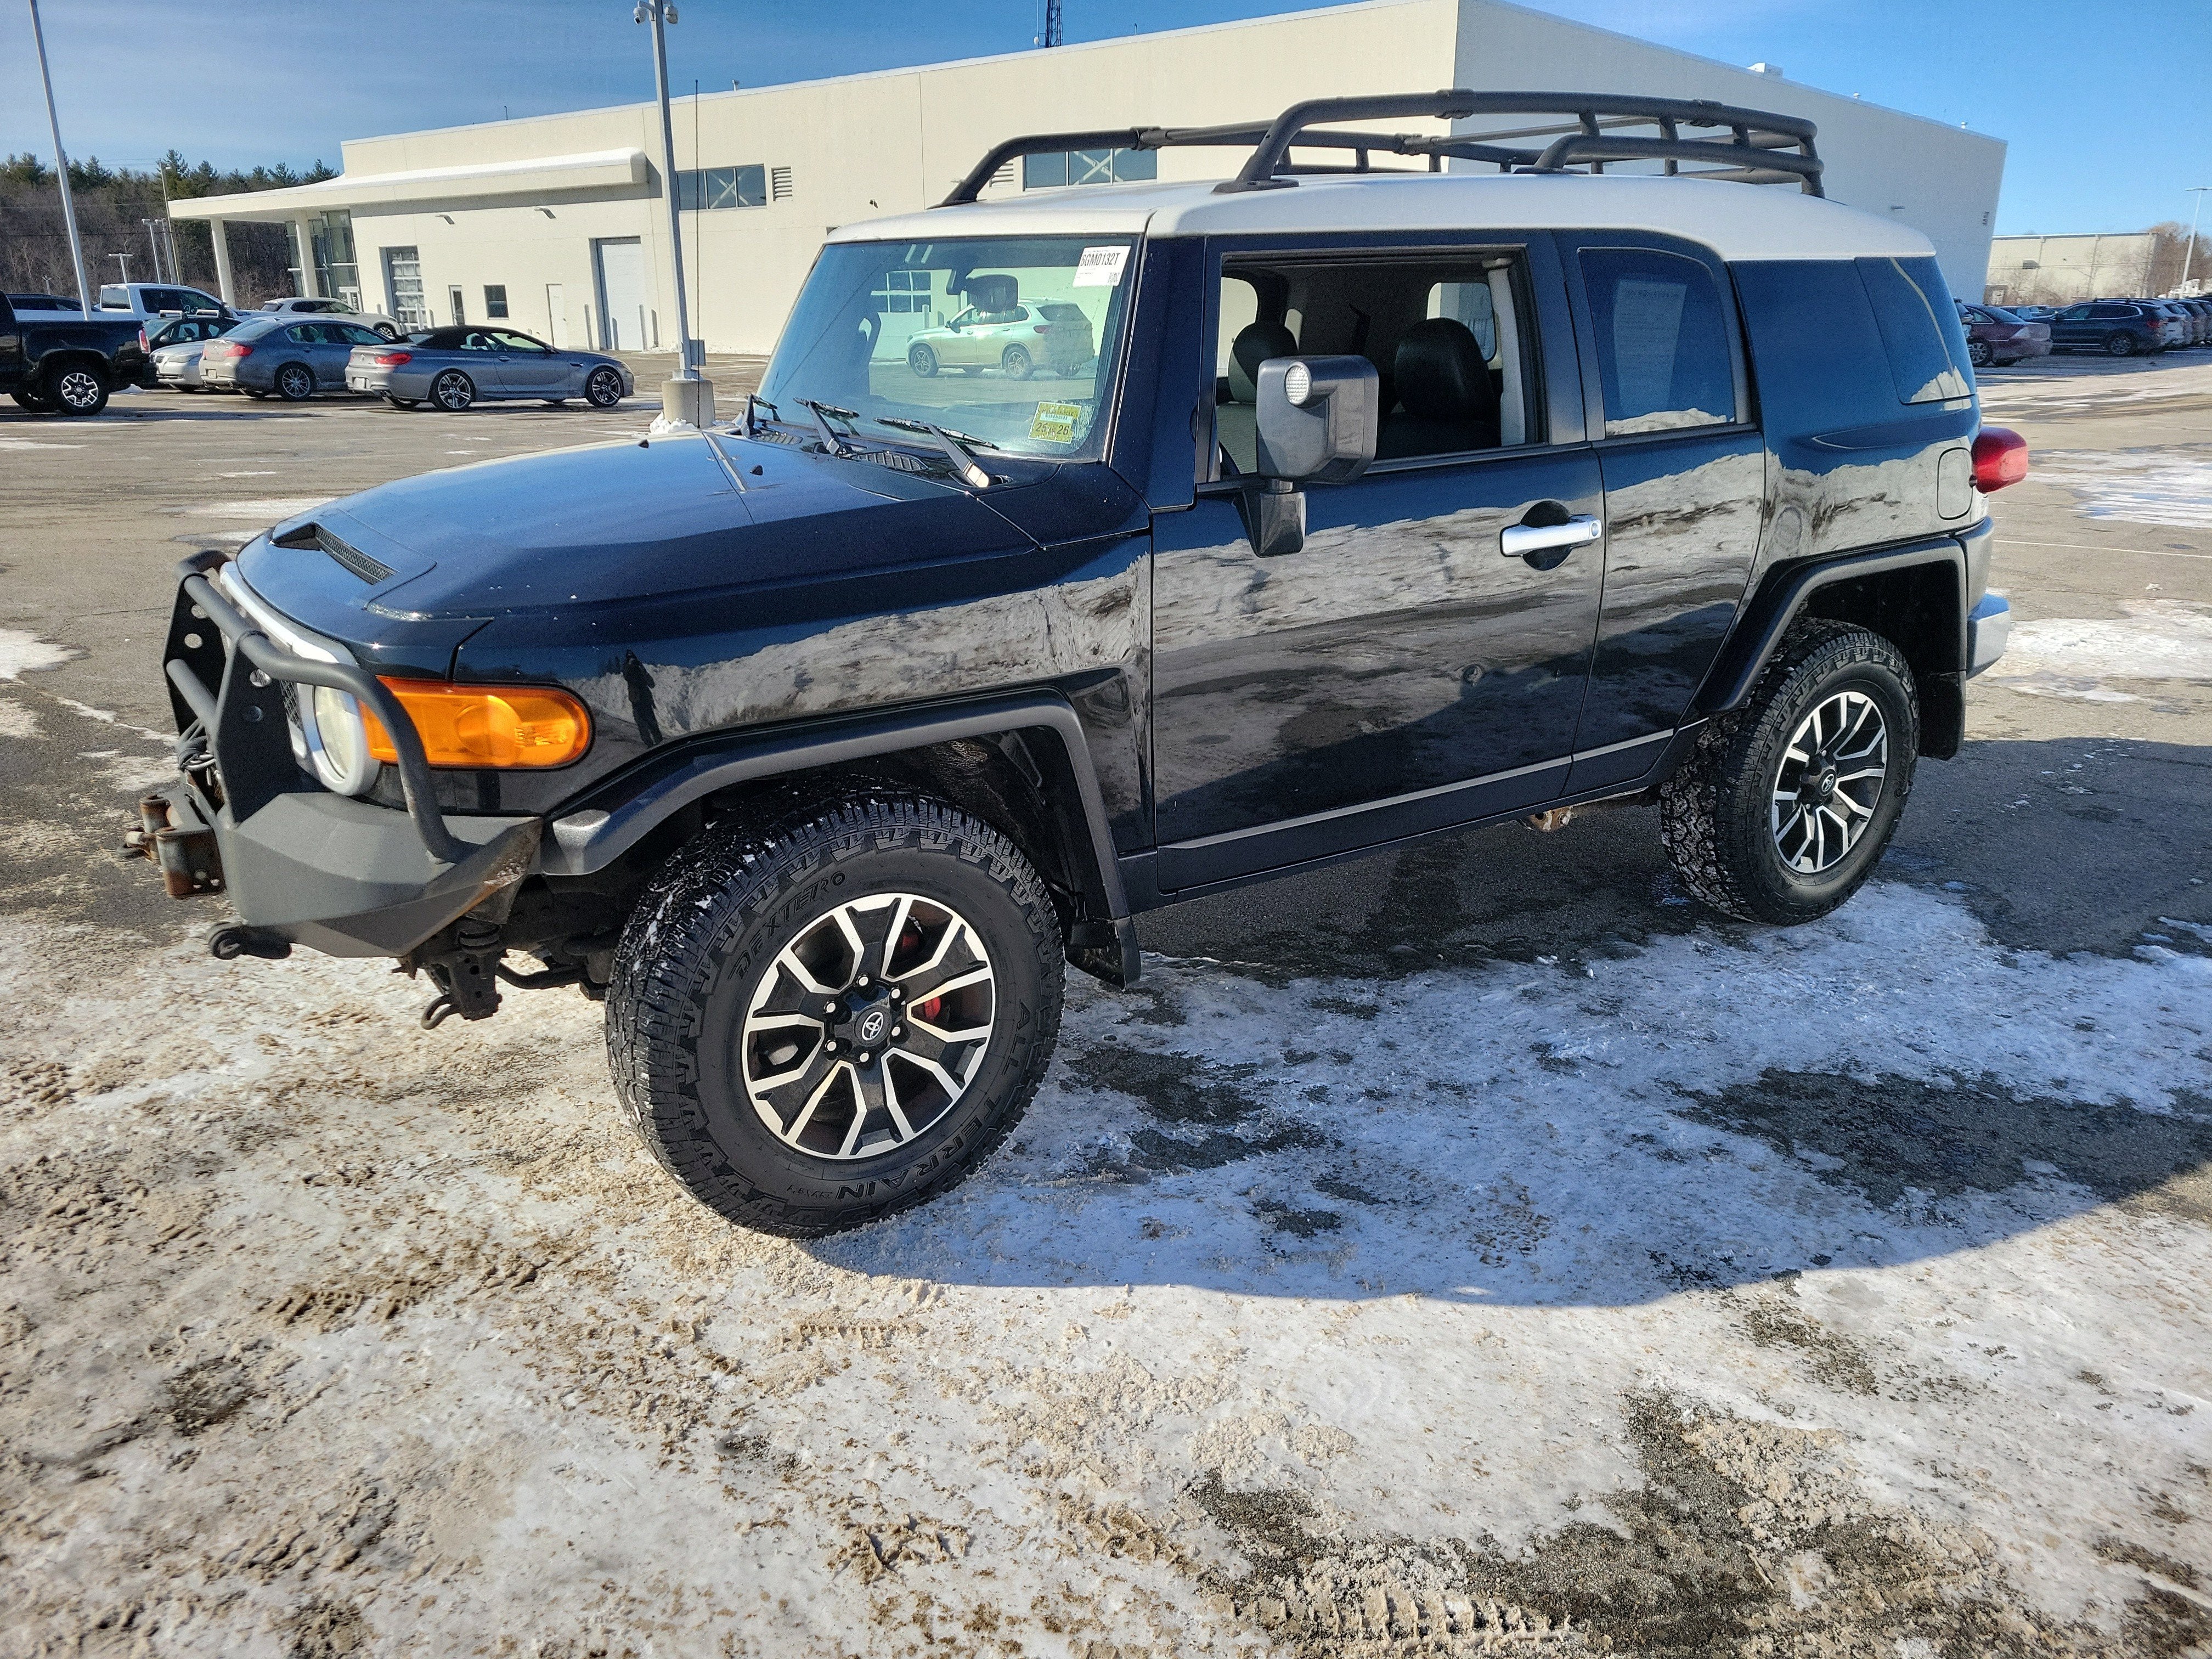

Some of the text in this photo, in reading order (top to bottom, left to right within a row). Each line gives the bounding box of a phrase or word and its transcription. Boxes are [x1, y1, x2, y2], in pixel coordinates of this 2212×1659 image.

[1057, 425, 1070, 436] 26
[727, 871, 845, 980] DEXTERO
[835, 998, 1031, 1200] ALL TERRAIN
